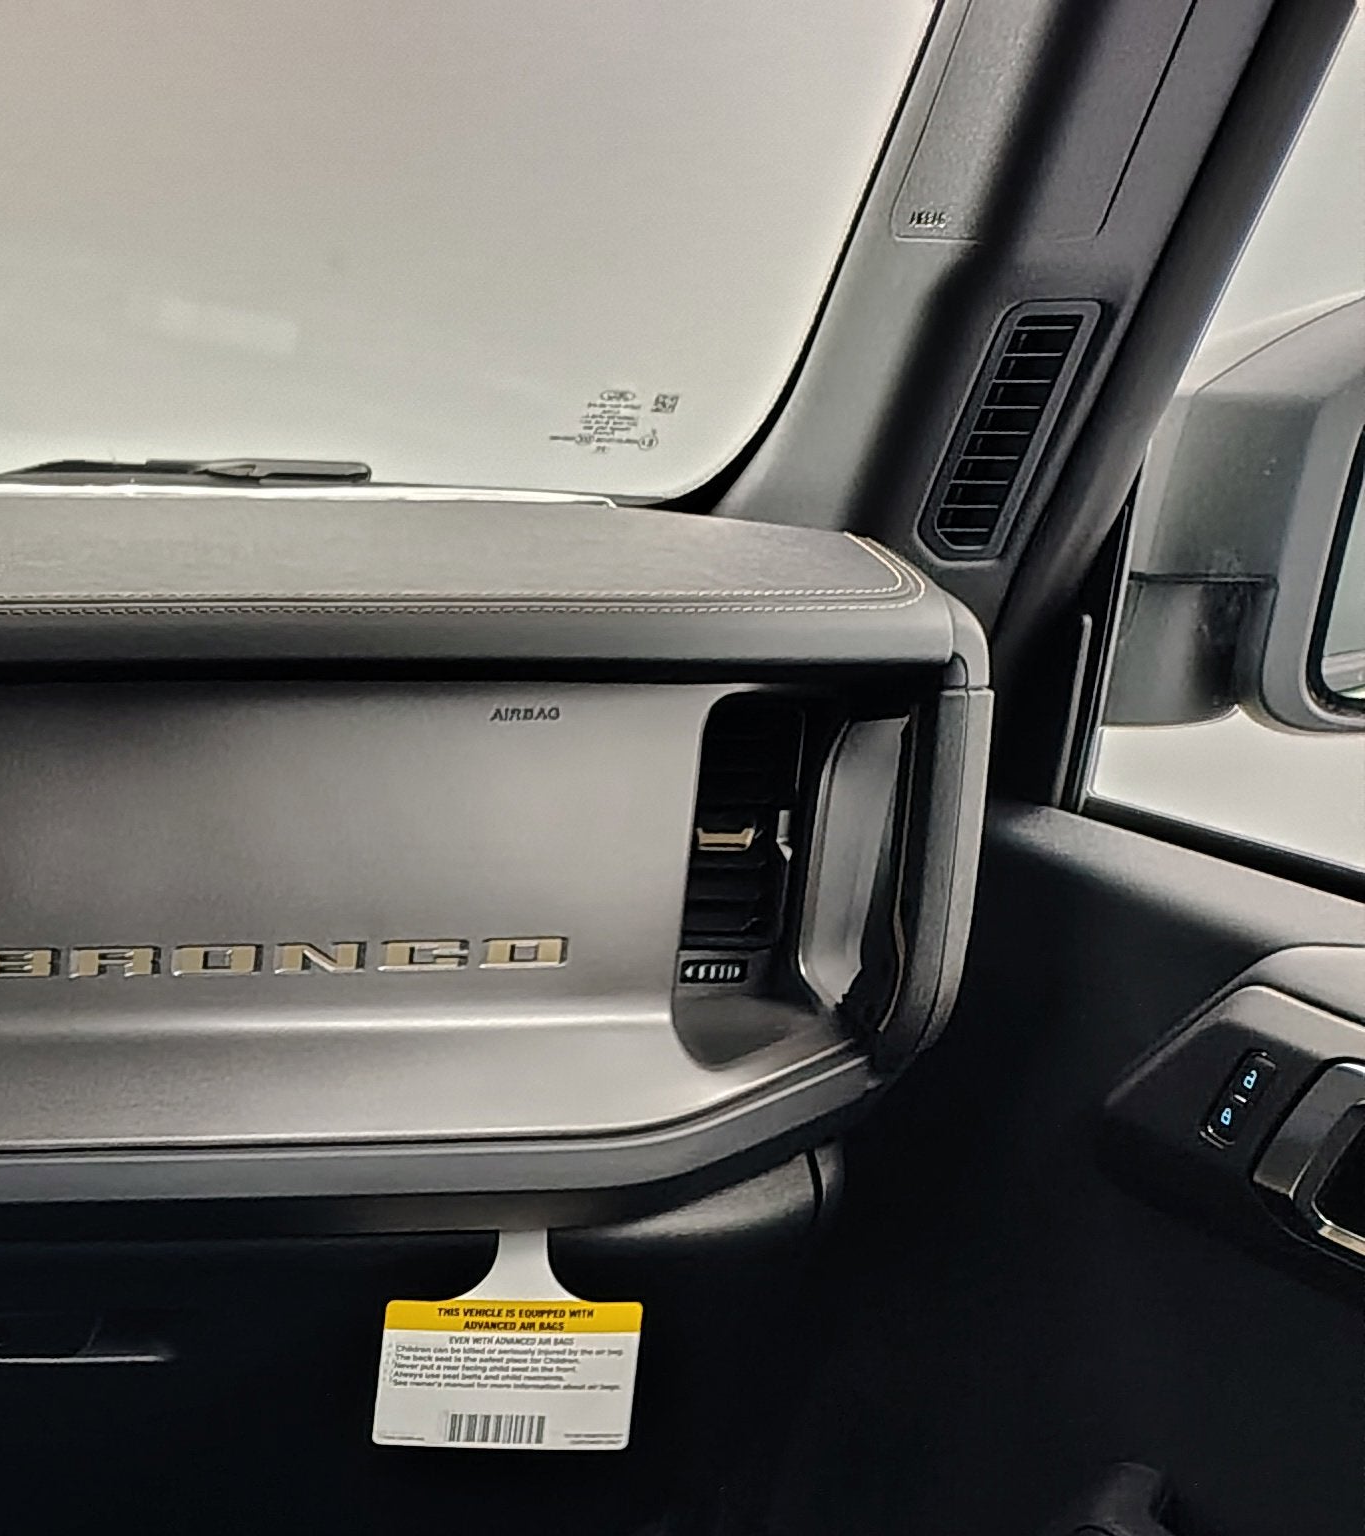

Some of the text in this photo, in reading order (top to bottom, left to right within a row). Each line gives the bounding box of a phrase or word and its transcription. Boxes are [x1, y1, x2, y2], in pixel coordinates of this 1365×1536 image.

[490, 706, 562, 722] AIRBAG
[437, 1307, 460, 1317] THIS
[463, 1308, 503, 1318] VEHICLE
[518, 1308, 566, 1319] EQUIPPED
[569, 1308, 594, 1319] WITH
[463, 1320, 565, 1332] ADVANCED AIR BAGS
